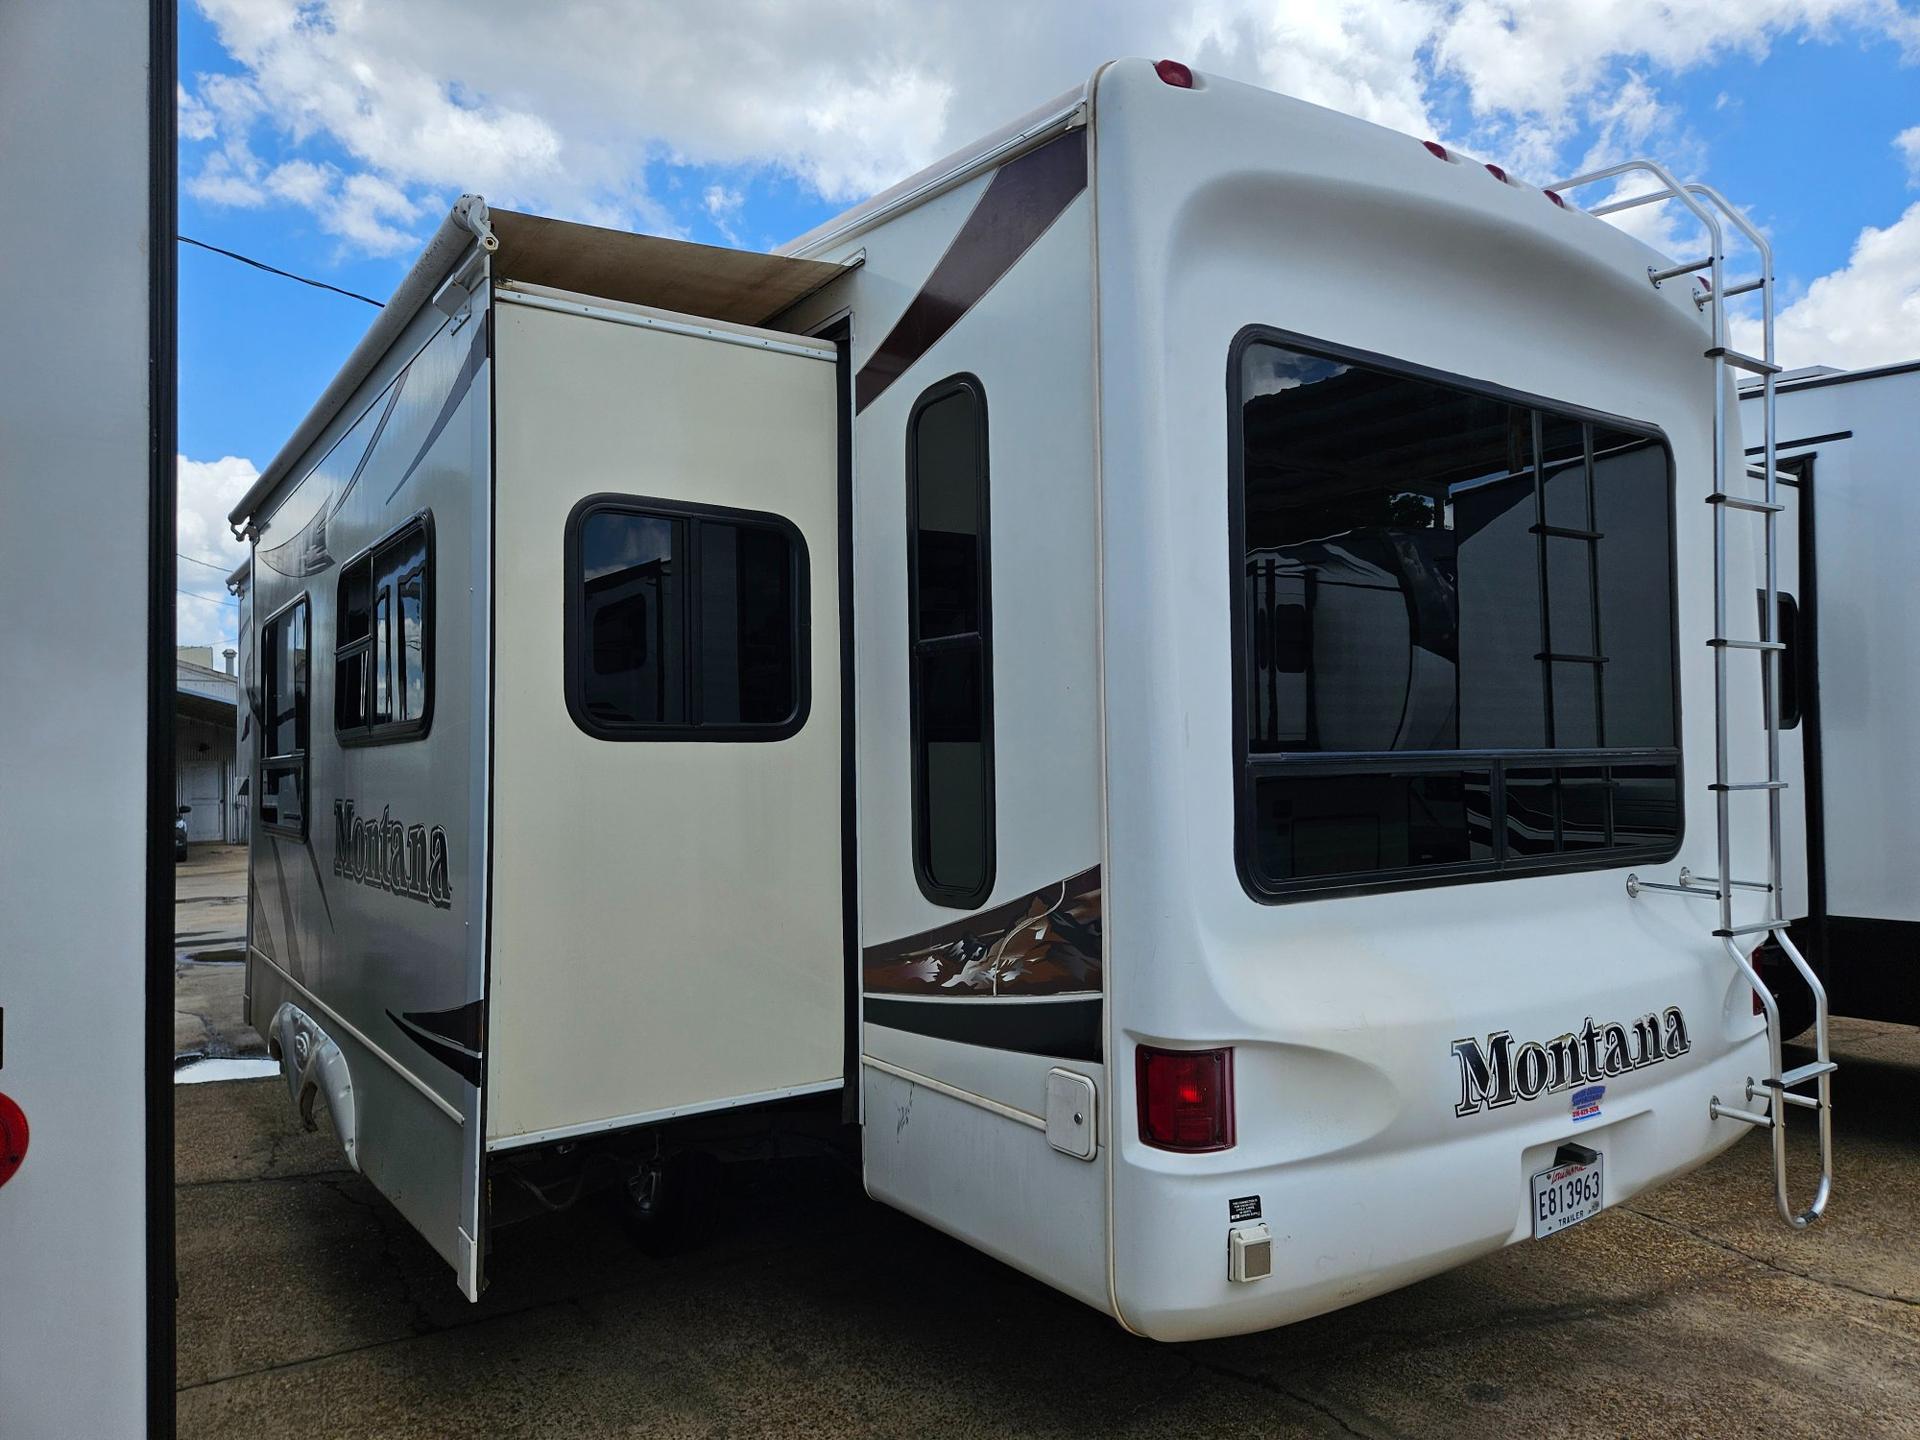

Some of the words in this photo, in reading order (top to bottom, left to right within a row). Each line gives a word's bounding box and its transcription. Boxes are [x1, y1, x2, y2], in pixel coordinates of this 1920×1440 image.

[333, 798, 453, 911] Montana
[1451, 1005, 1691, 1118] Montana
[1539, 1171, 1600, 1221] E813963
[1558, 1210, 1584, 1227] TRAILER
